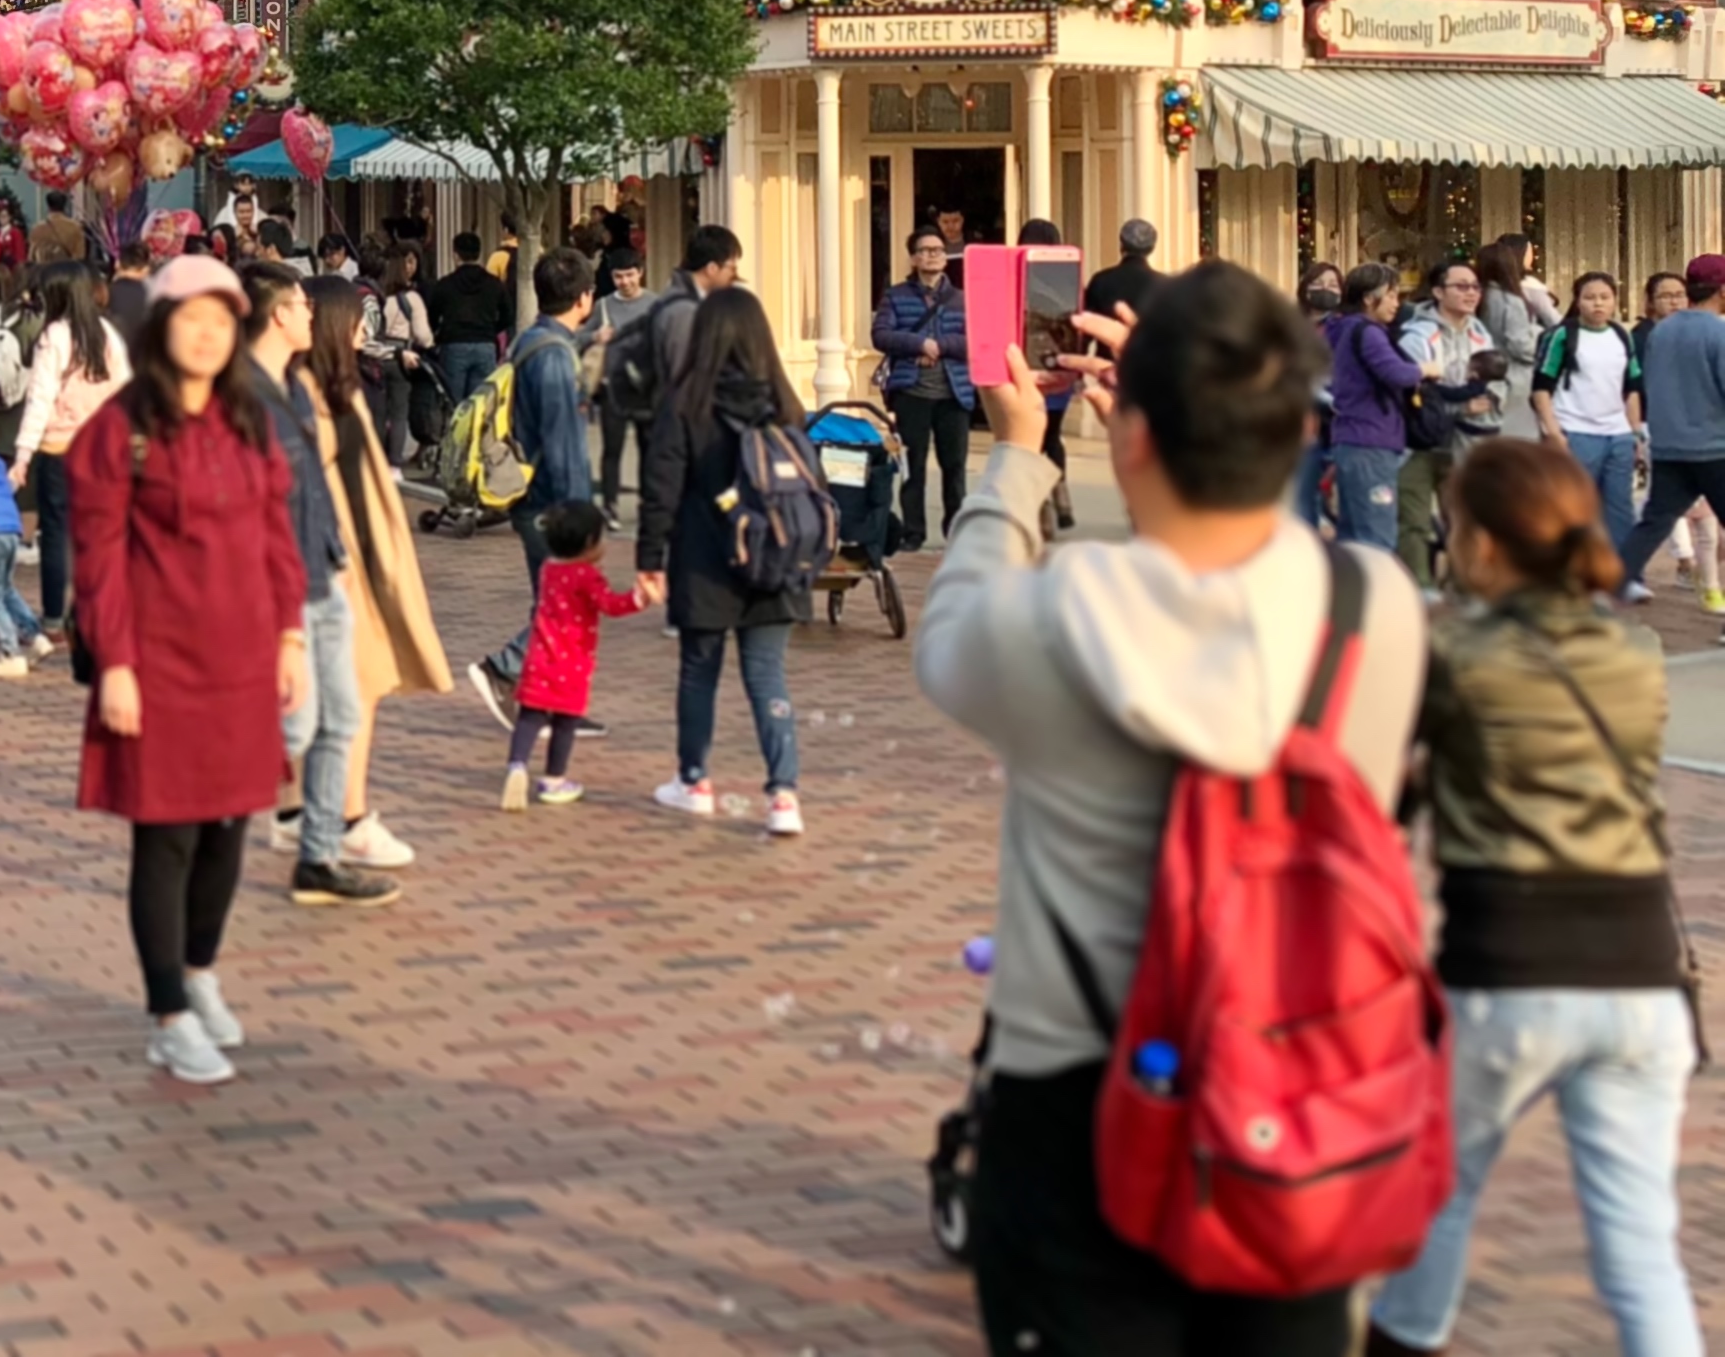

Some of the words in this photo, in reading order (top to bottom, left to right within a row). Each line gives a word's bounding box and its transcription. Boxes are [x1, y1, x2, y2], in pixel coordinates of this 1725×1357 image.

[829, 22, 876, 43] MAIN
[884, 20, 953, 42] STREET
[961, 18, 1038, 40] SWEETS
[1341, 7, 1433, 47] Deliciously
[1439, 9, 1522, 43] Delectable
[1527, 5, 1591, 38] Delights
